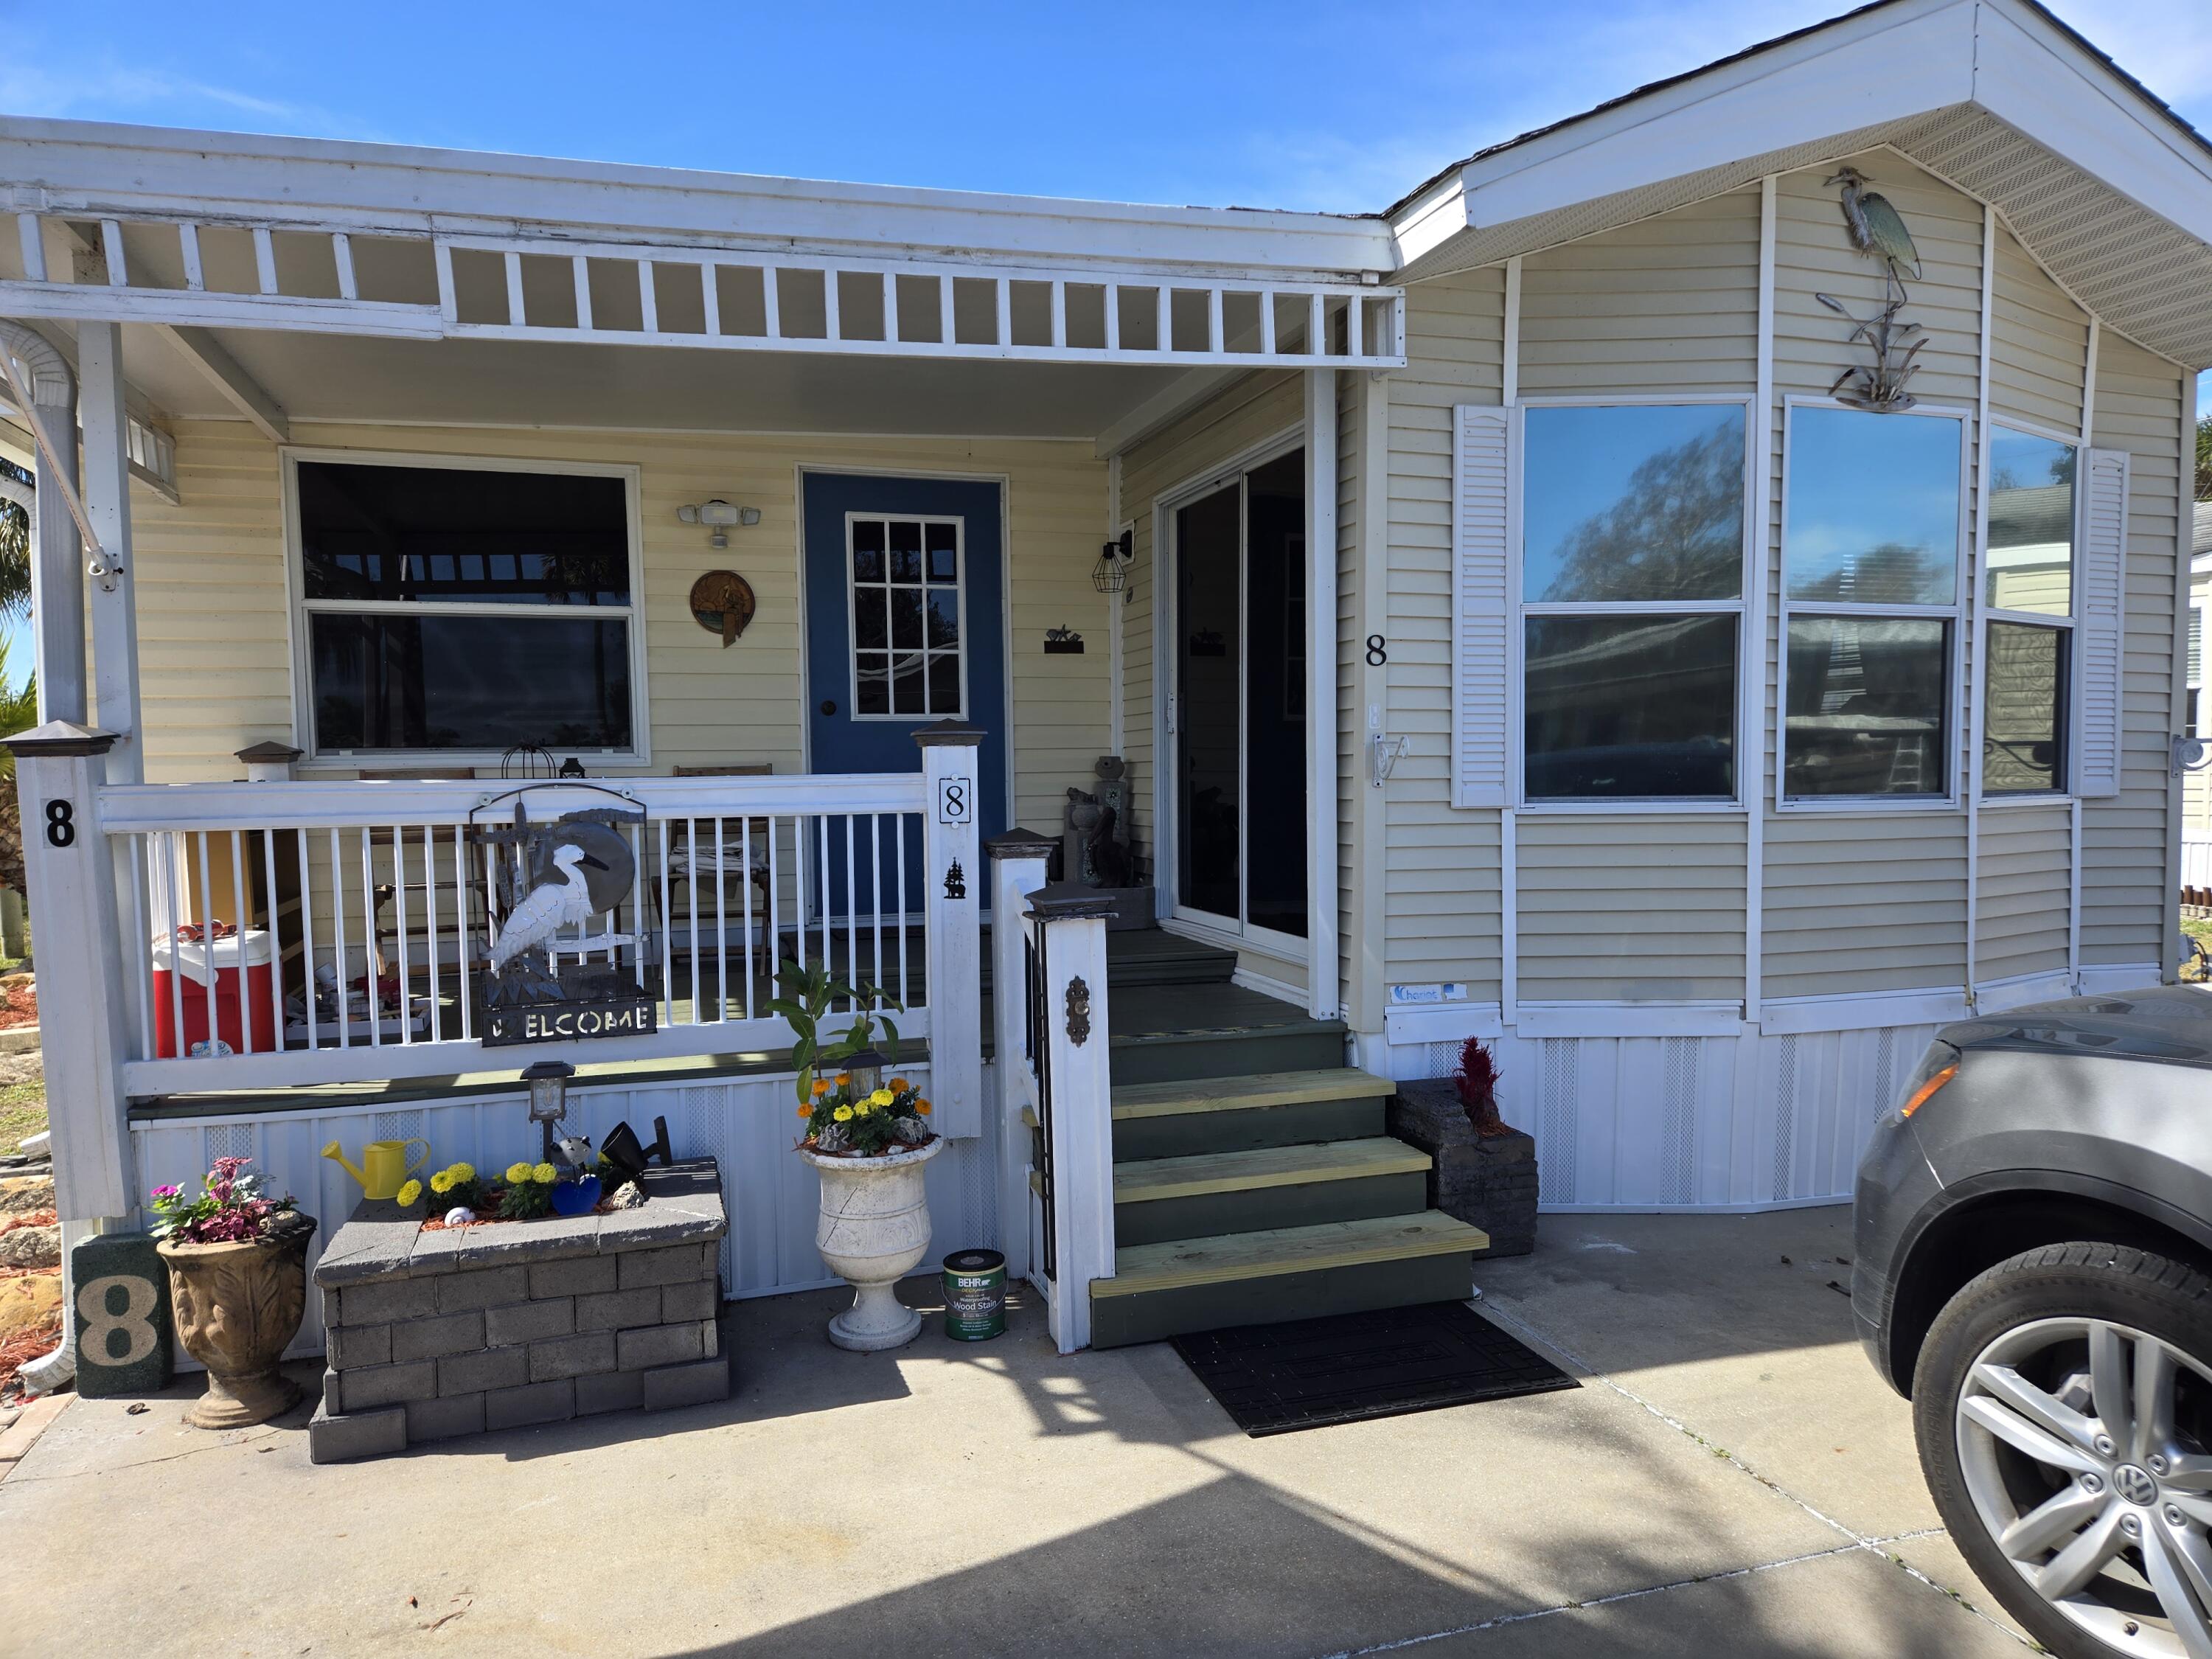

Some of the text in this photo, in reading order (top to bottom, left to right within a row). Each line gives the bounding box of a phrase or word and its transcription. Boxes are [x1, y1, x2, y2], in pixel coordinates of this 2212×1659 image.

[1366, 634, 1387, 667] 8
[946, 785, 964, 816] 8
[46, 799, 75, 847] 8
[958, 1277, 981, 1287] BEHR
[77, 1275, 158, 1366] 8
[953, 1299, 997, 1310] Wood Stain
[2115, 1465, 2157, 1504] VW
